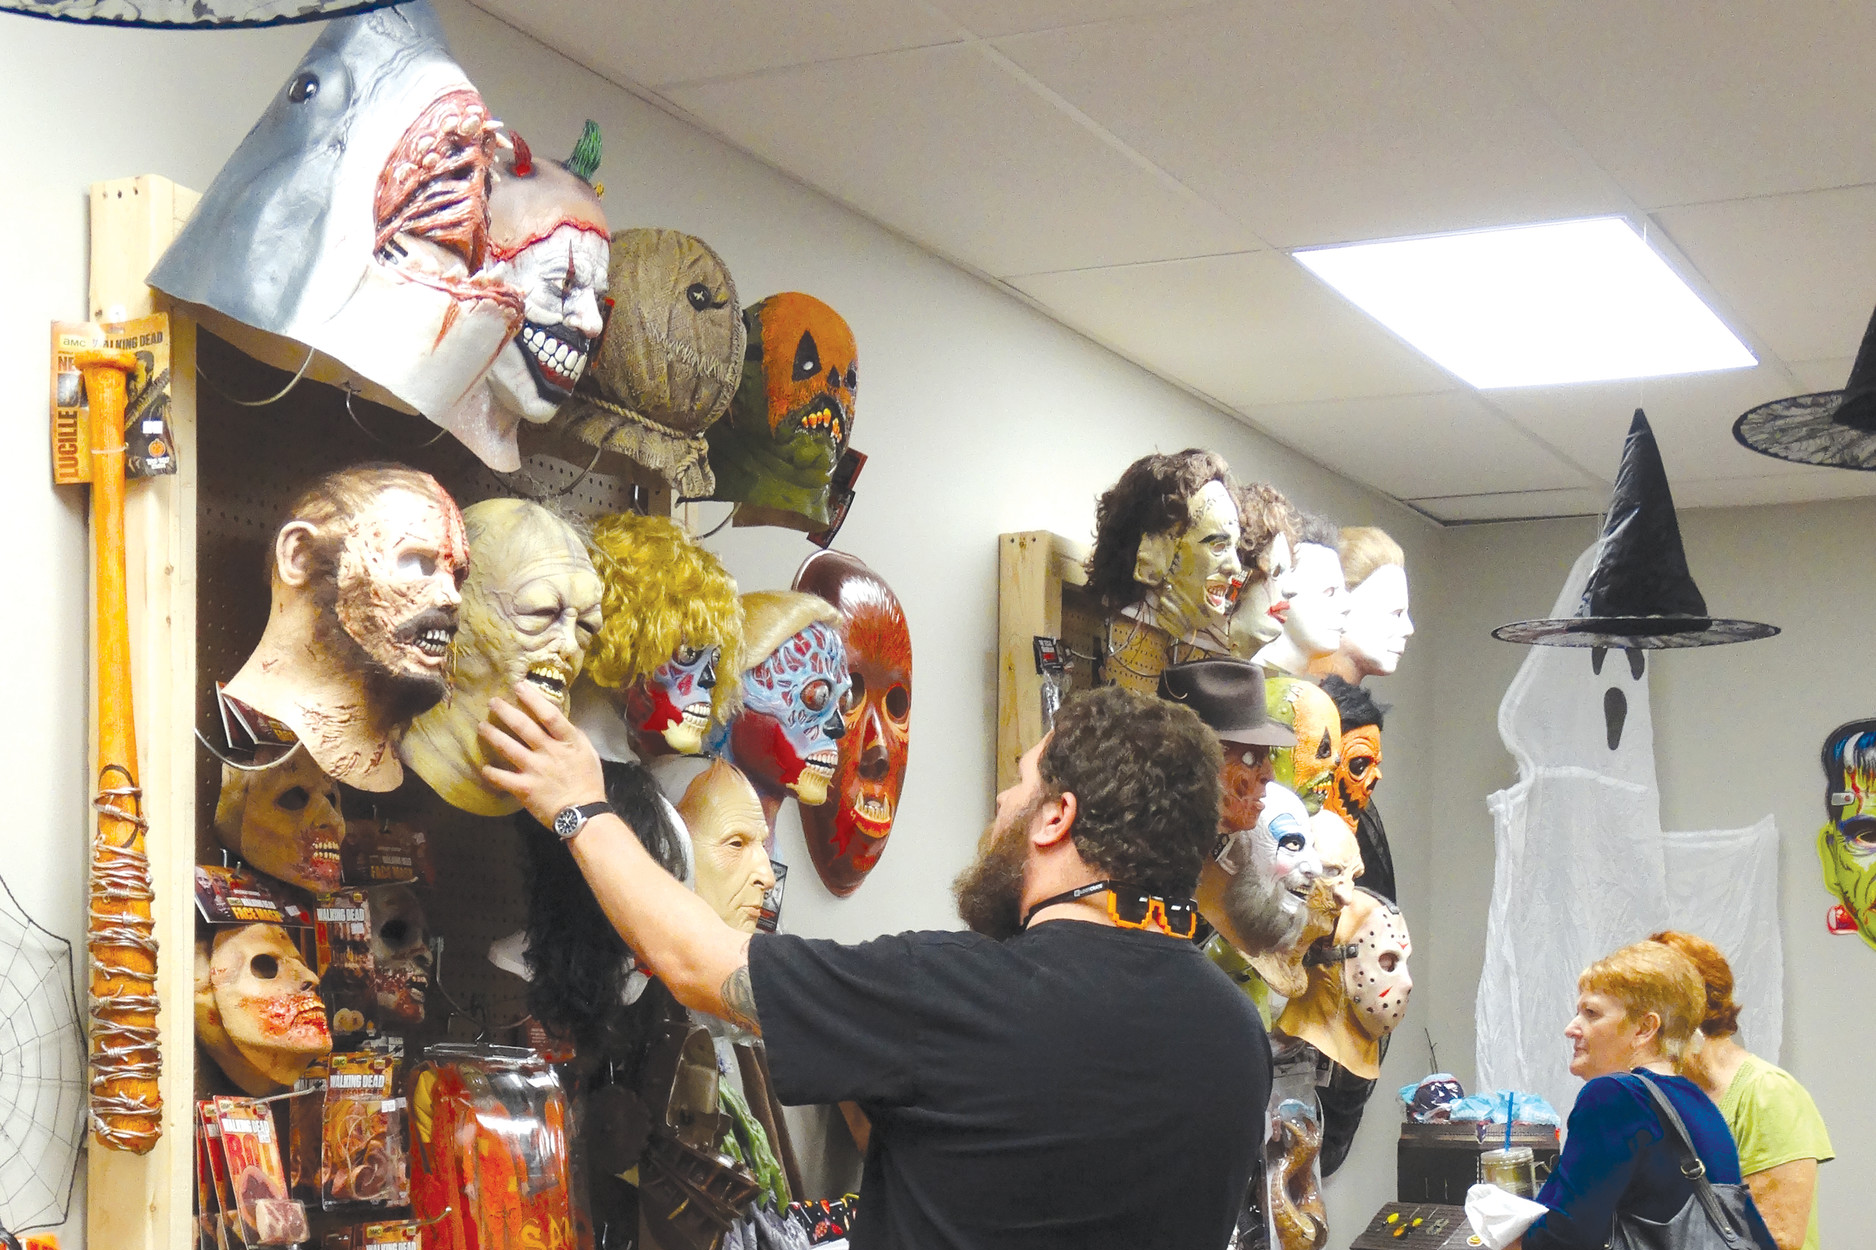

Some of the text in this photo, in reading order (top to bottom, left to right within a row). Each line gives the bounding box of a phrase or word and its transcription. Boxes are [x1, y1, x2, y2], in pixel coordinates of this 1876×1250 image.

[139, 331, 163, 346] DEAD
[58, 410, 79, 479] LUCILLE
[346, 908, 364, 921] DEAD
[330, 1075, 362, 1088] WALKING
[363, 1075, 384, 1088] DEAD
